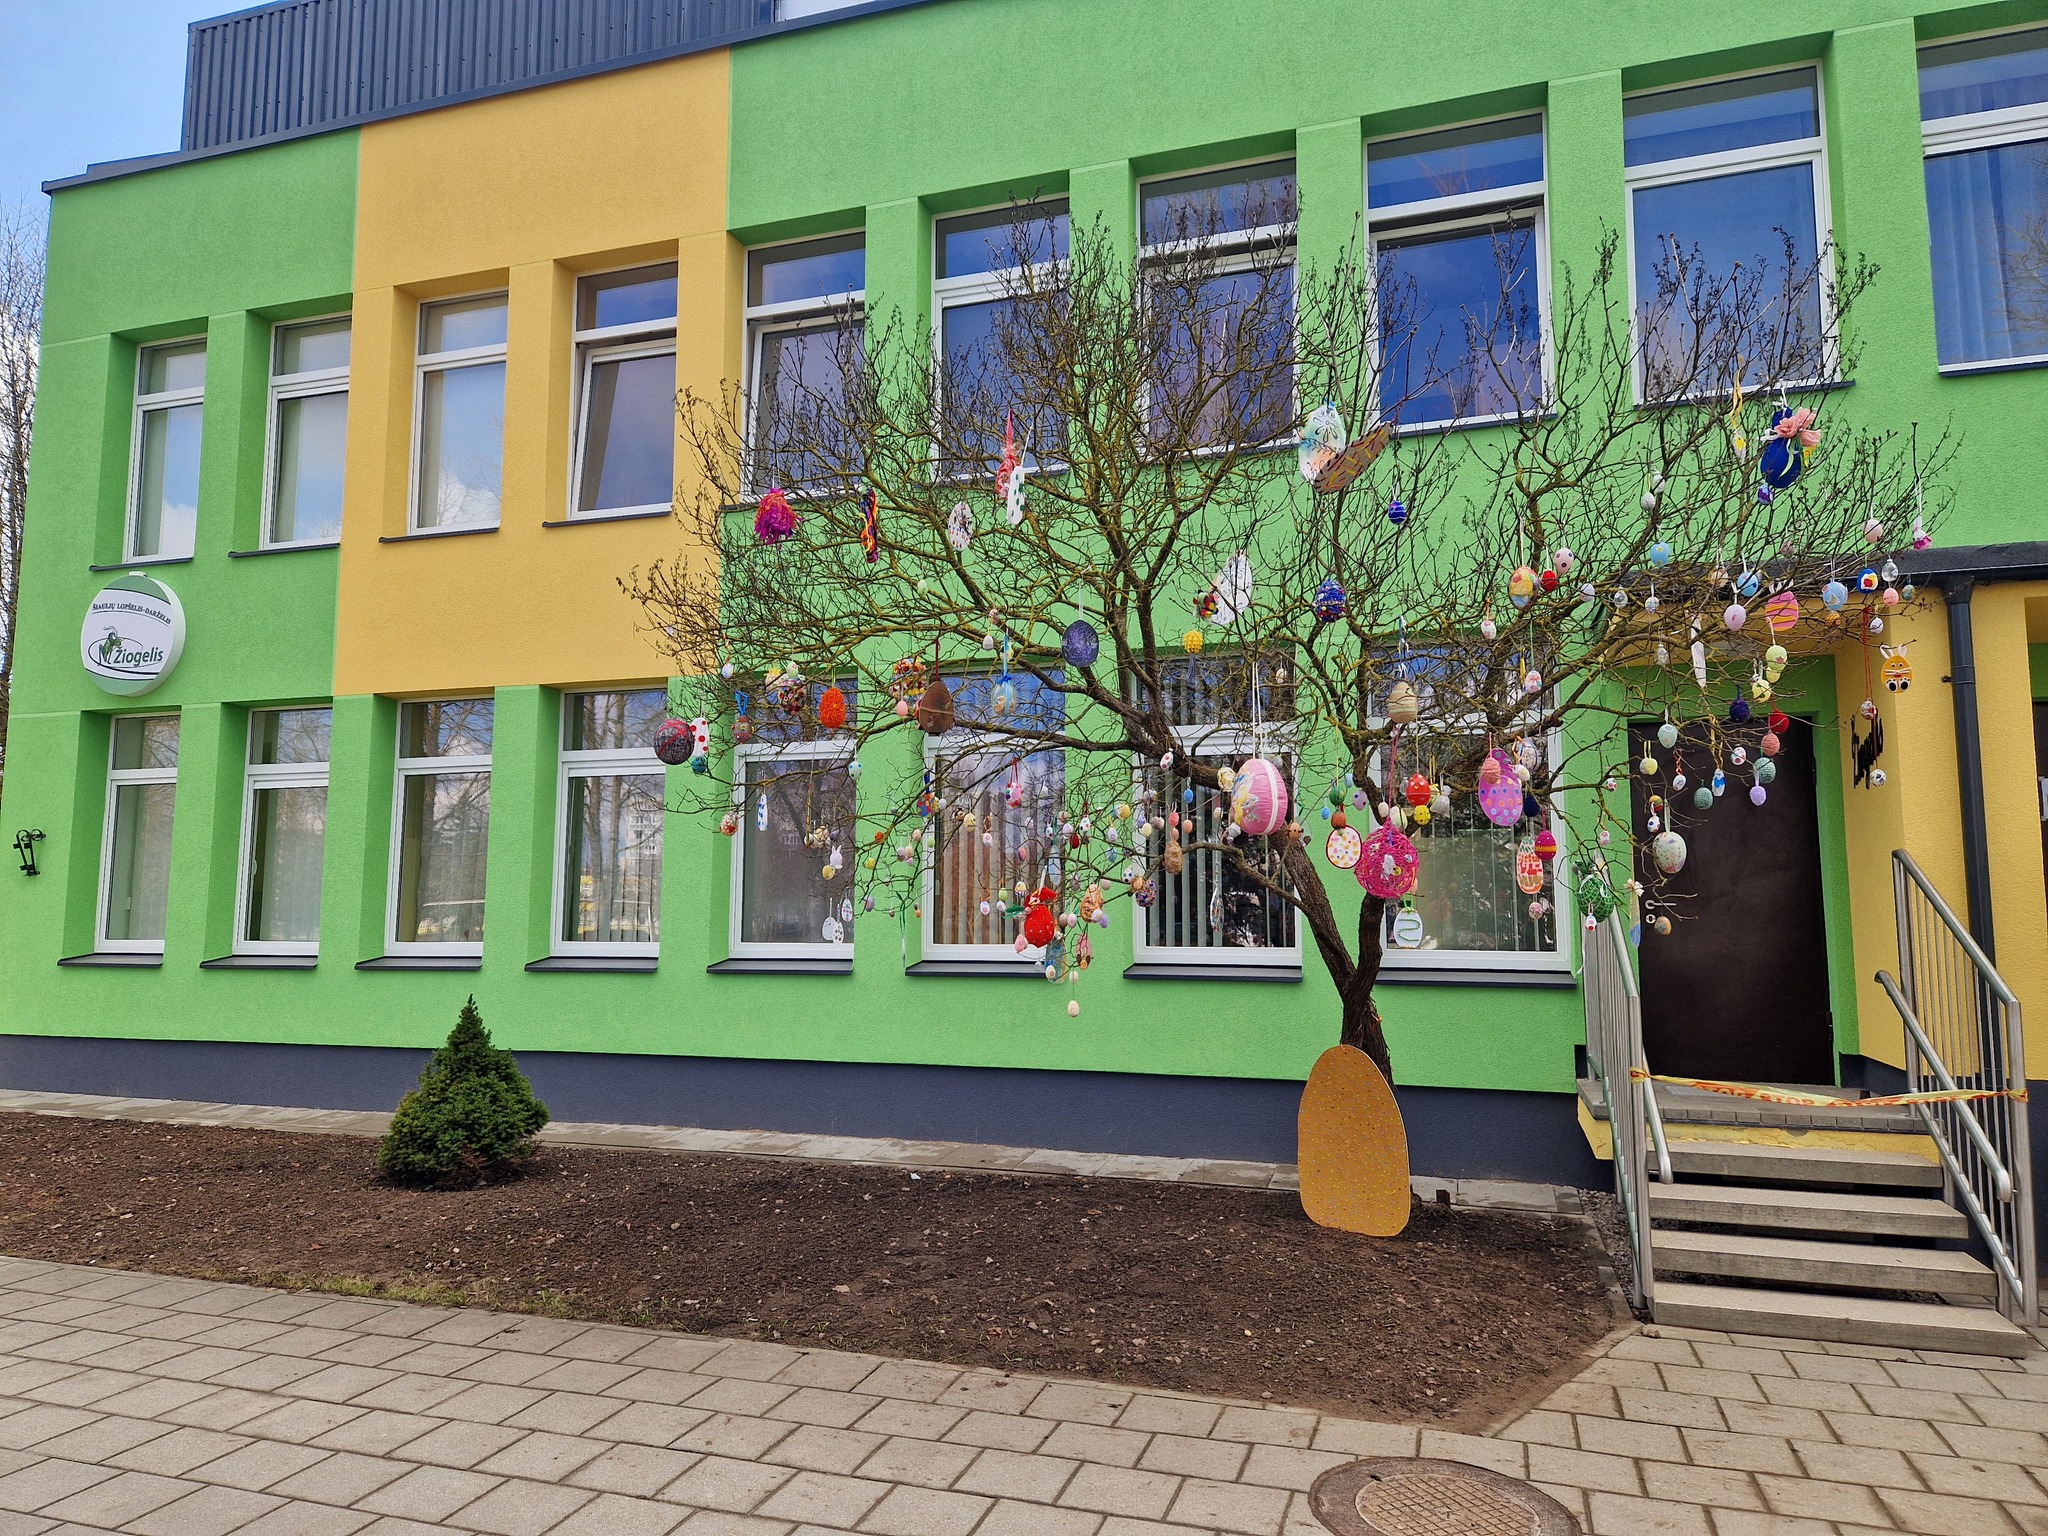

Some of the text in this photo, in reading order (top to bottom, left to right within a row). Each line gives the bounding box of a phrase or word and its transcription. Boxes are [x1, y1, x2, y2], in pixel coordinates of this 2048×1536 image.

[92, 602, 172, 625] ŠIAULIŲ LOPŠELIS-DARŽELIS
[113, 646, 164, 668] Žiogelis
